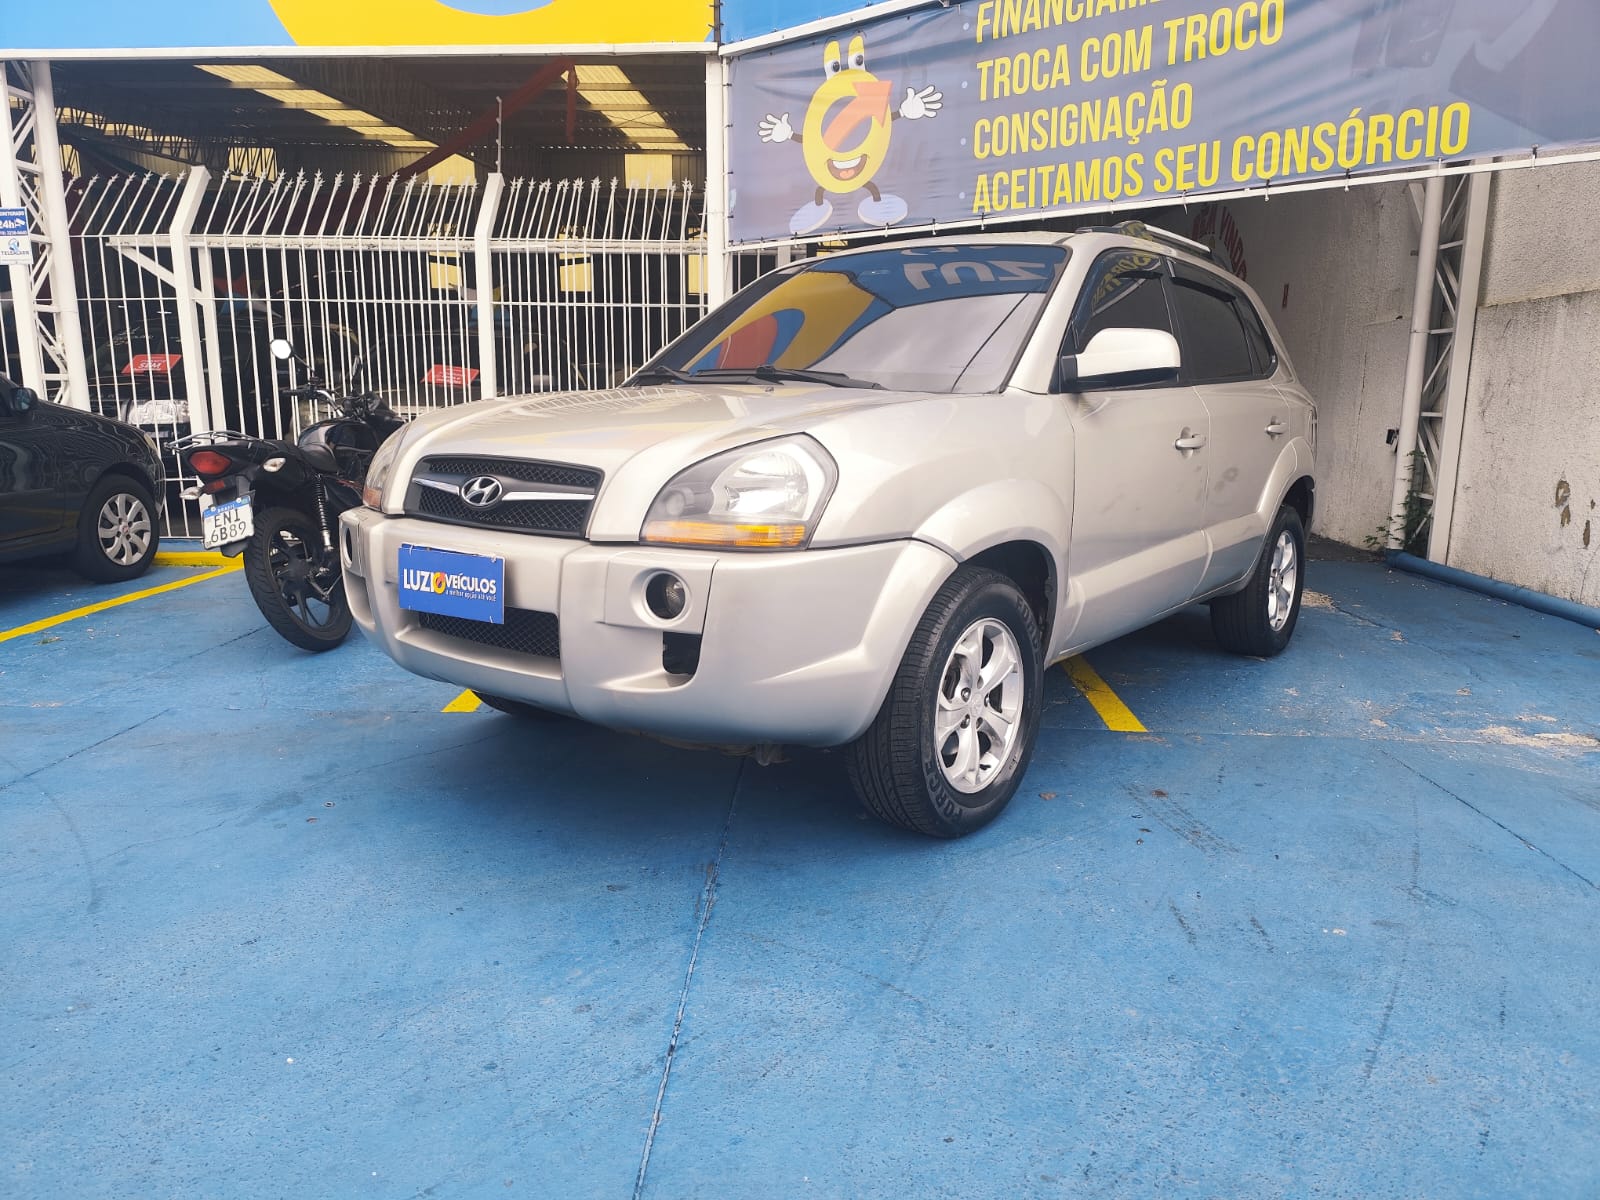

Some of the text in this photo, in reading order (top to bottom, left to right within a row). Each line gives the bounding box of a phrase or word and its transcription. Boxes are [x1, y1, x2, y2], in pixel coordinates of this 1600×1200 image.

[976, 0, 1162, 43] FINANC
[976, 0, 1286, 101] TROCA COM TROCO
[973, 79, 1194, 160] CONSIGNAÇÃO
[972, 102, 1471, 214] ACEITAMOS SEU CONSÓRCIO
[211, 521, 247, 543] 6B89
[214, 509, 241, 529] ENI
[444, 572, 497, 595] VEÍCULOS
